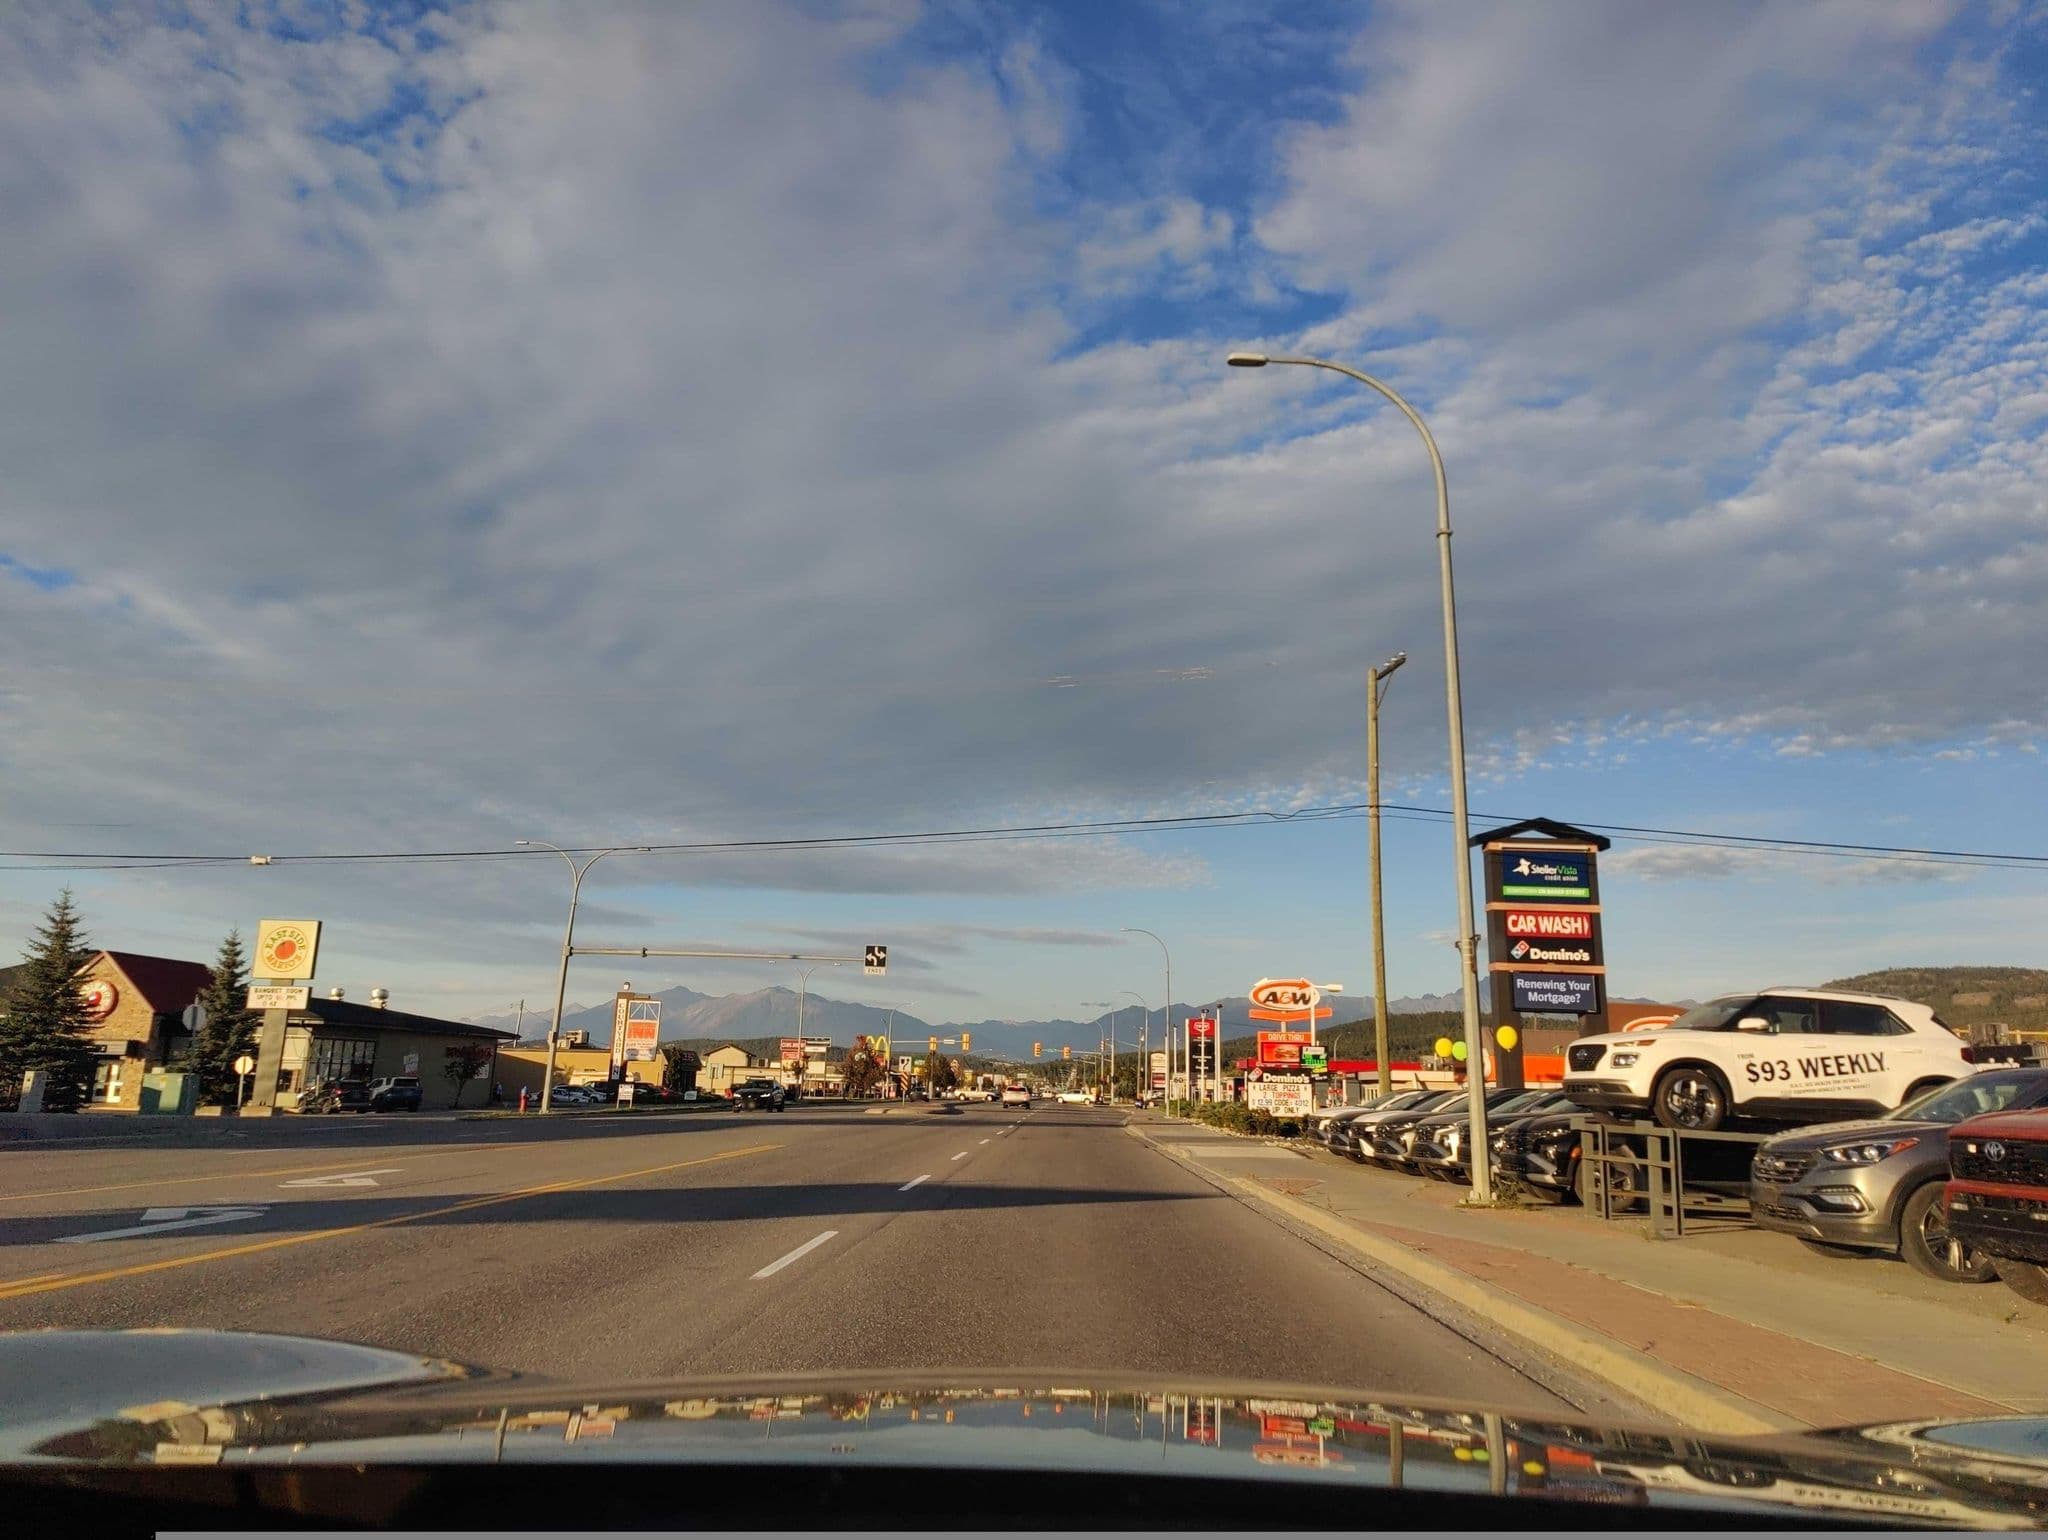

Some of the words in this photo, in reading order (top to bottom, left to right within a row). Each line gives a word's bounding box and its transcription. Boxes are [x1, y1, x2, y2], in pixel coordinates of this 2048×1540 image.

[1507, 914, 1537, 933] CAR
[1538, 915, 1582, 935] WASH
[1529, 947, 1590, 961] Domino's
[1516, 978, 1566, 992] Renewing
[1568, 980, 1591, 991] Your
[1263, 991, 1312, 1005] A&W
[1527, 991, 1581, 1005] Mortgage?
[1267, 1033, 1286, 1041] DRIVE
[1287, 1033, 1305, 1041] THRU
[1262, 1072, 1310, 1084] Domino's
[1745, 1059, 1791, 1084] $93
